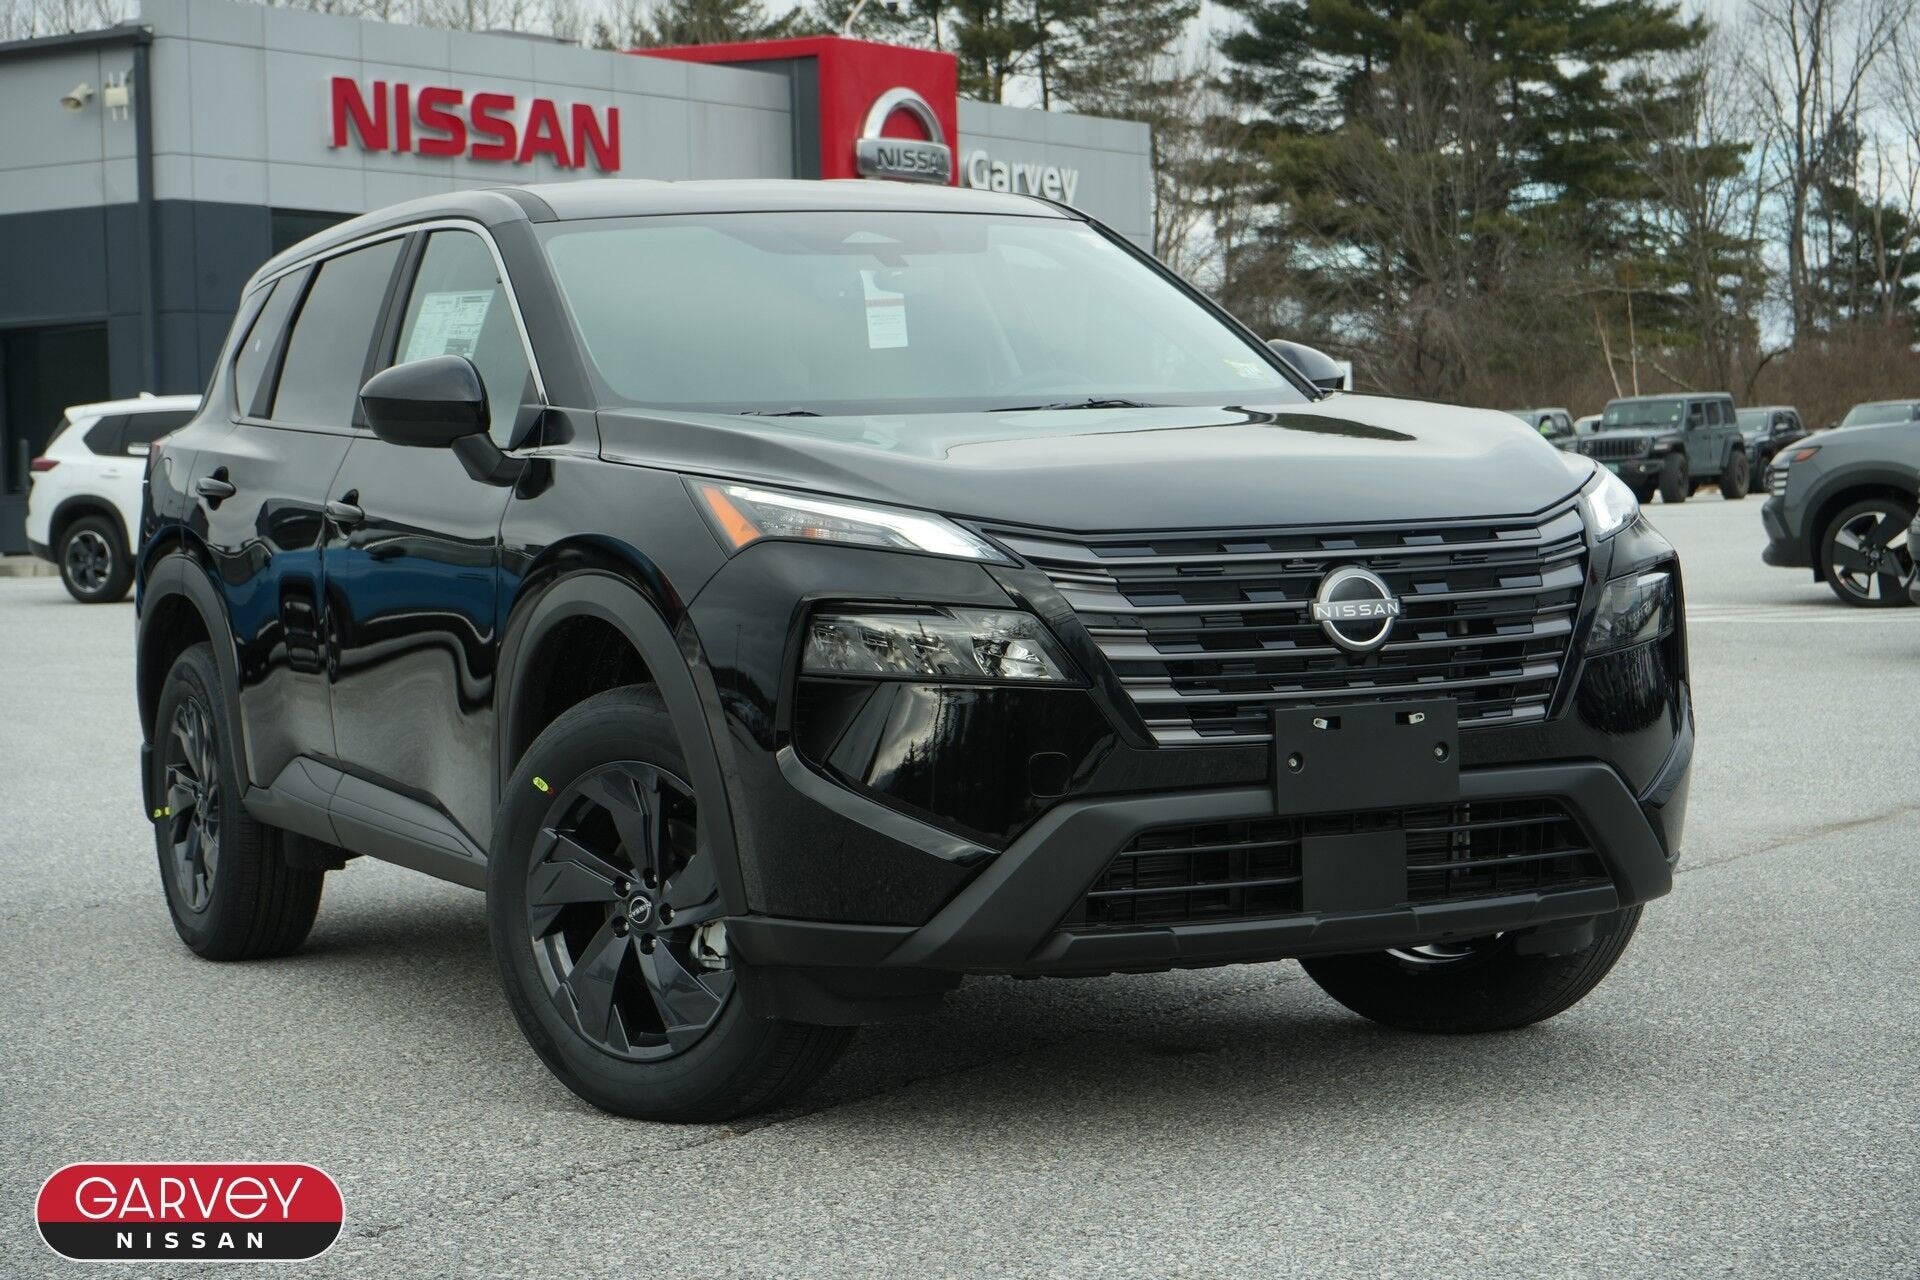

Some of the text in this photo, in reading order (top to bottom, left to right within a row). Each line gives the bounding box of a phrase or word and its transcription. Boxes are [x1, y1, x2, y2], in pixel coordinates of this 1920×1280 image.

[332, 77, 620, 171] NISSAN
[967, 150, 1079, 204] Garvey
[1316, 602, 1399, 617] NISSAN
